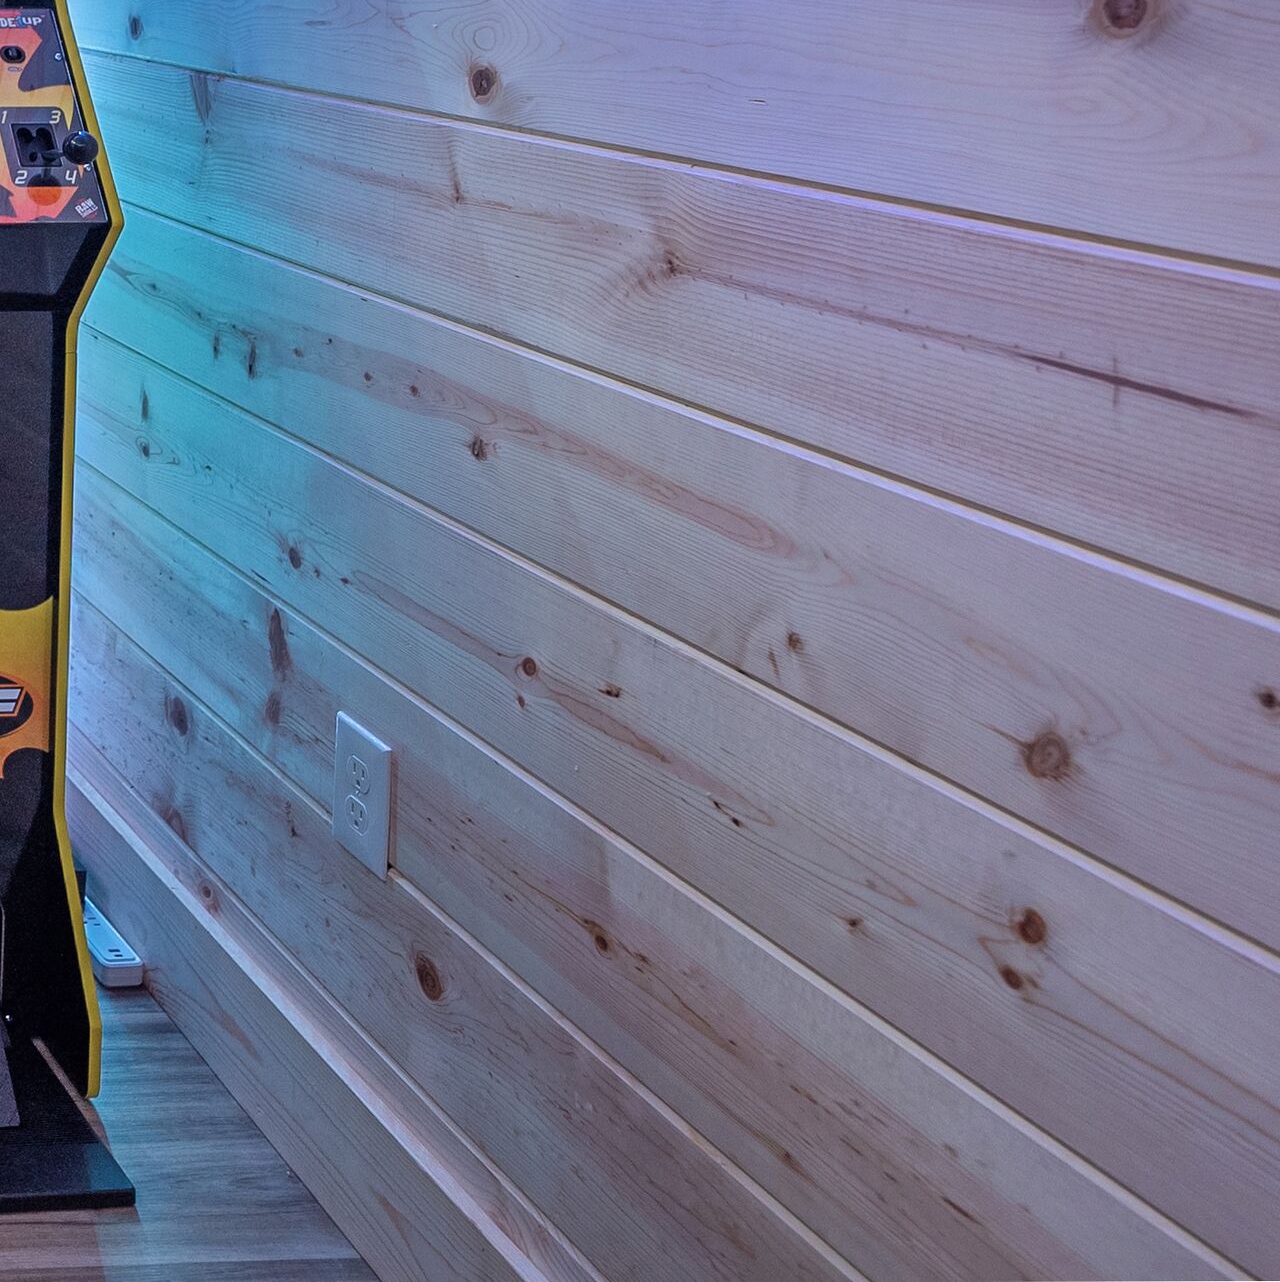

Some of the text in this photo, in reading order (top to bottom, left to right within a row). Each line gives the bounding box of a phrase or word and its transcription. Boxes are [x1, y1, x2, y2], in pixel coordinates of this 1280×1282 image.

[1, 110, 62, 124] 1 3
[14, 169, 77, 184] 2 4
